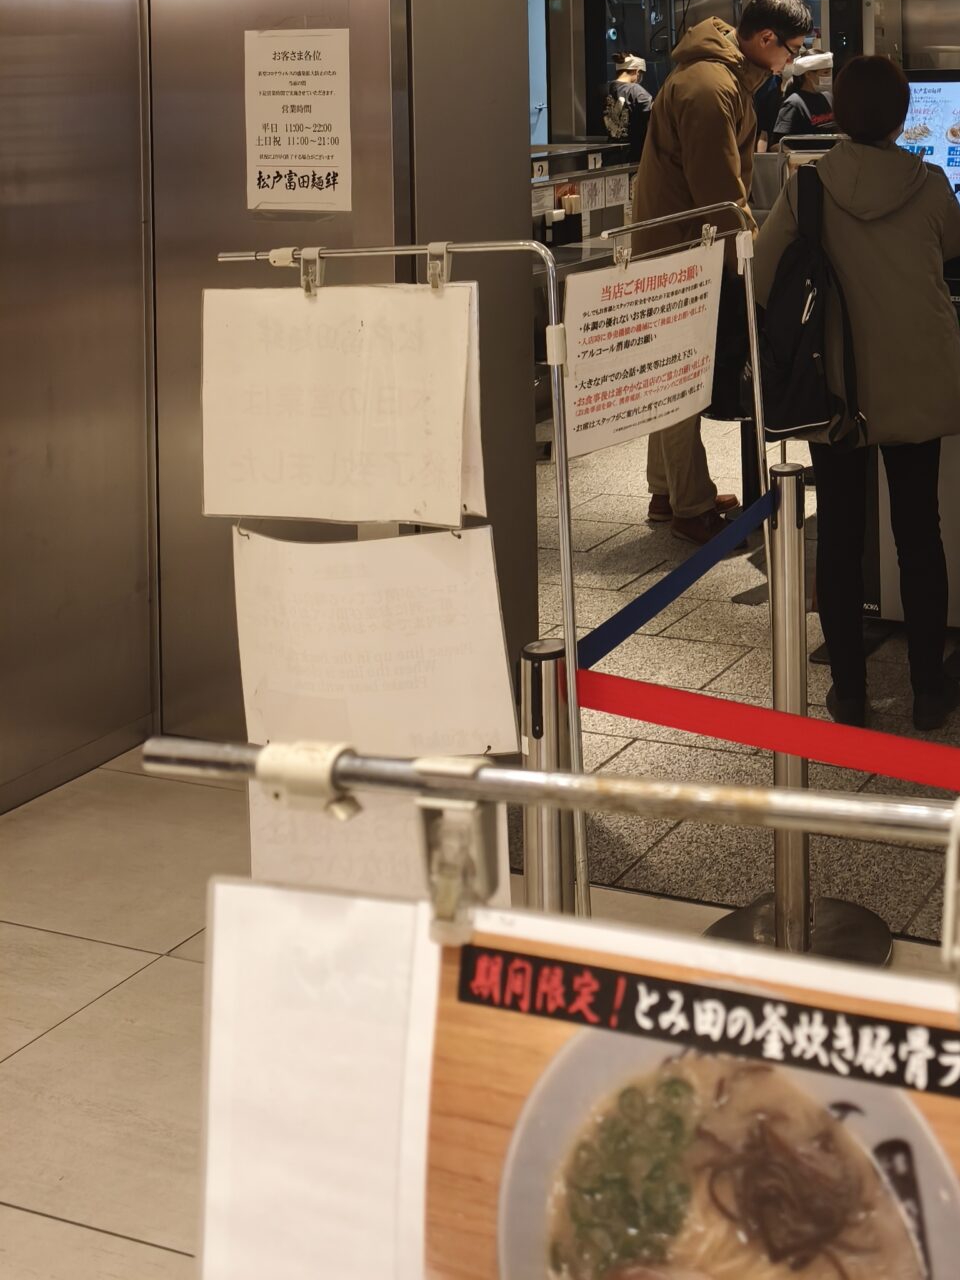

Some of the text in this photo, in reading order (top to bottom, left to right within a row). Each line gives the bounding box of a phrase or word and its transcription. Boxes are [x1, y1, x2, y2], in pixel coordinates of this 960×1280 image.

[272, 50, 322, 61] お客さま各位
[281, 104, 312, 114] 営業時間
[261, 123, 278, 133] 平日
[255, 136, 282, 147] 土日祝
[256, 169, 339, 192] 松戸富田麺絆
[600, 264, 703, 302] 当店ご利用時のお願い
